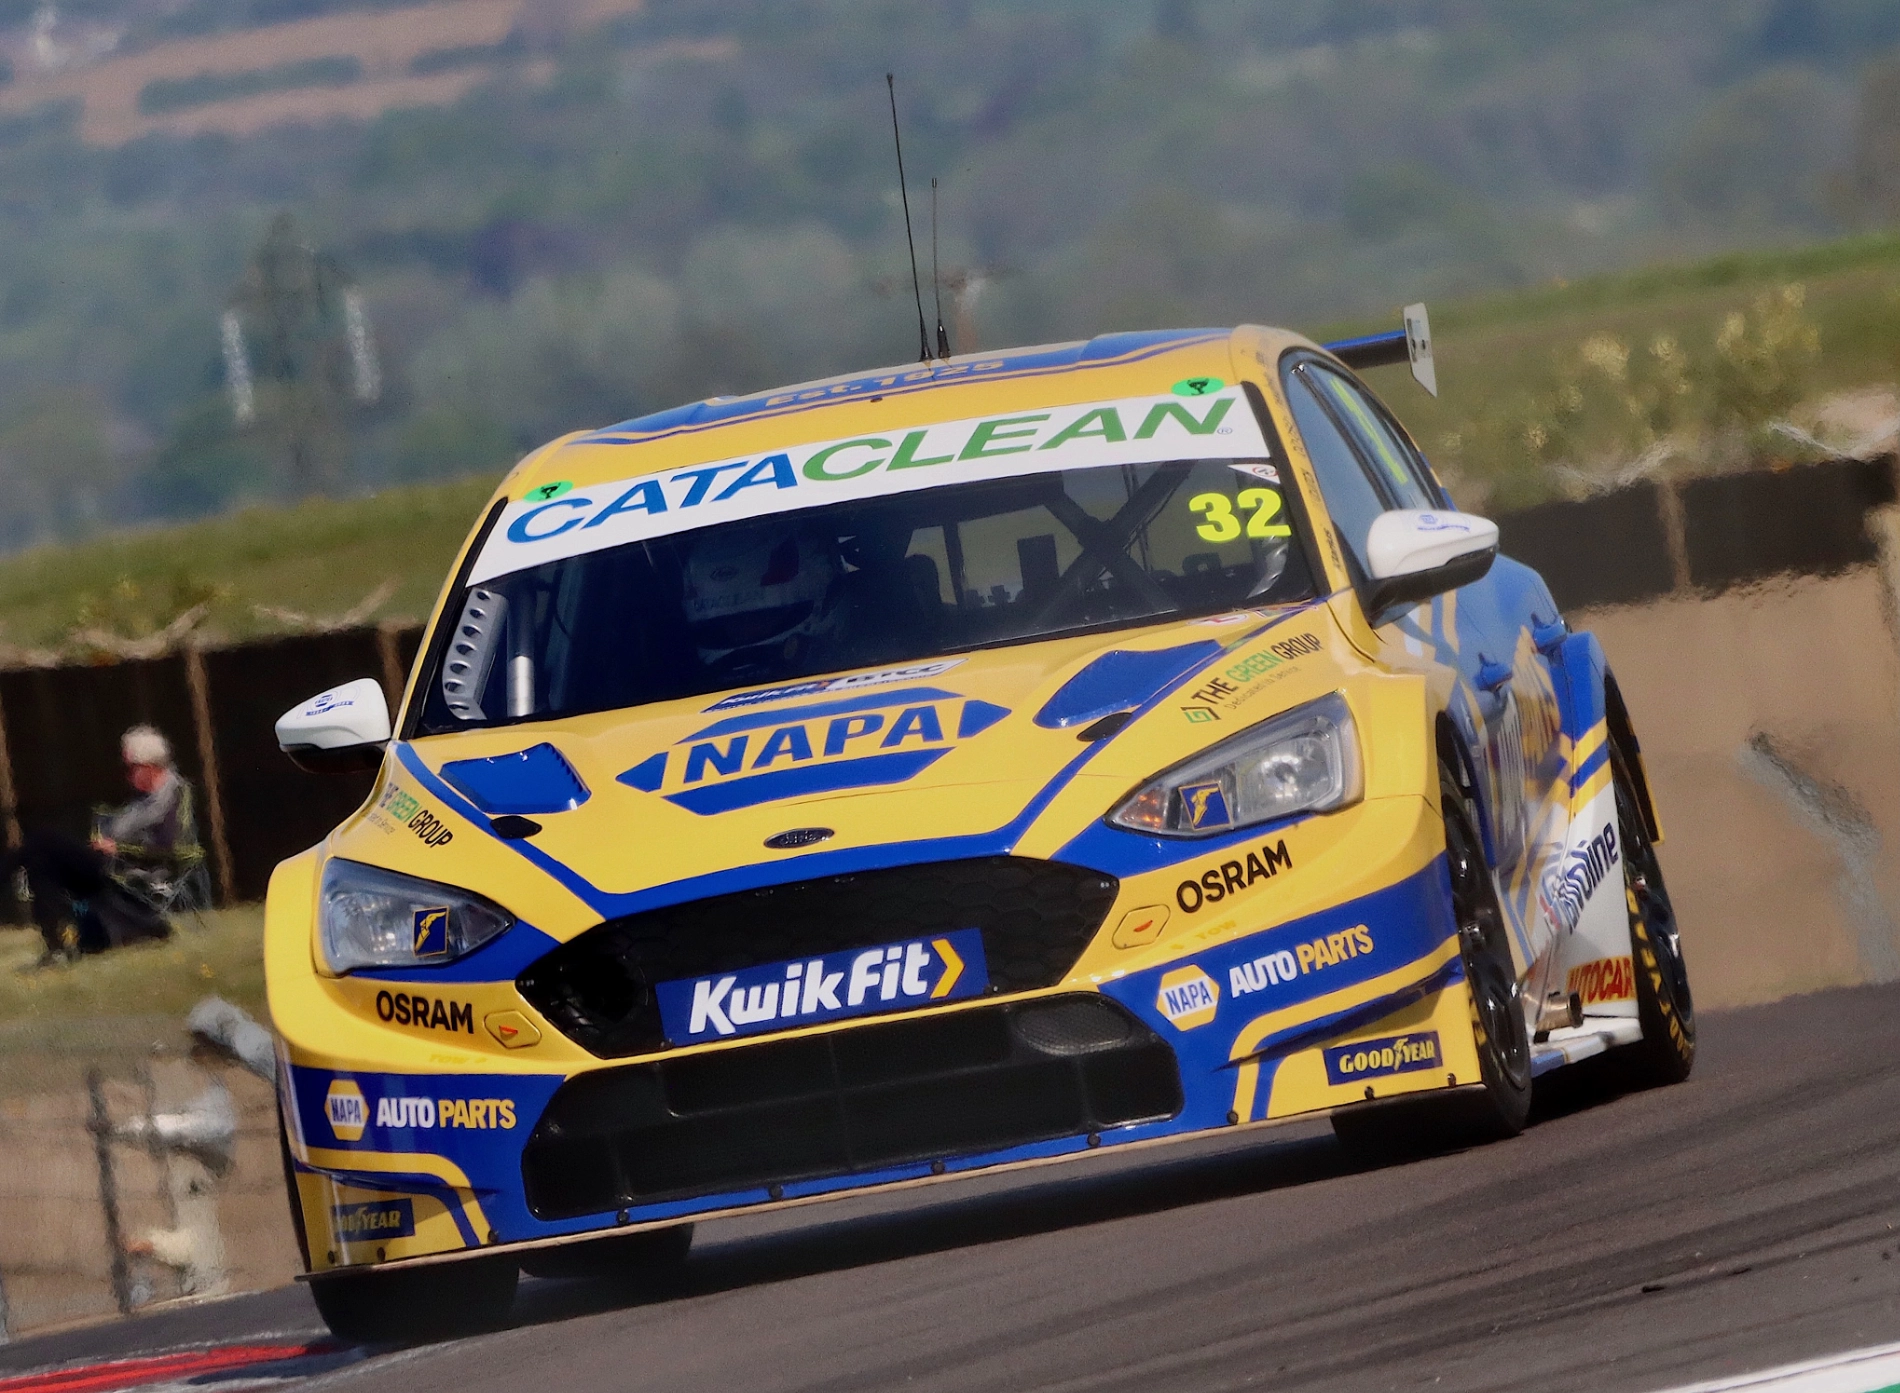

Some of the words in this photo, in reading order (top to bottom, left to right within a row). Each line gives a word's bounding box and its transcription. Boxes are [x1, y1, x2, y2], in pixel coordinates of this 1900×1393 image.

[507, 397, 1237, 544] CATACLEAN
[1188, 488, 1292, 542] 32
[1190, 676, 1240, 705] THE
[1224, 649, 1285, 683] GREEN
[1269, 632, 1324, 661] GROUP
[682, 704, 944, 785] NAPA
[407, 808, 454, 849] GROUP
[1175, 839, 1293, 914] OSRAM
[375, 989, 475, 1035] OSRAM
[1164, 979, 1214, 1017] NAPA
[1338, 1037, 1437, 1074] GOODYEAR
[329, 1096, 363, 1126] NAPA
[376, 1096, 436, 1129] AUTO
[438, 1098, 517, 1130] PARTS
